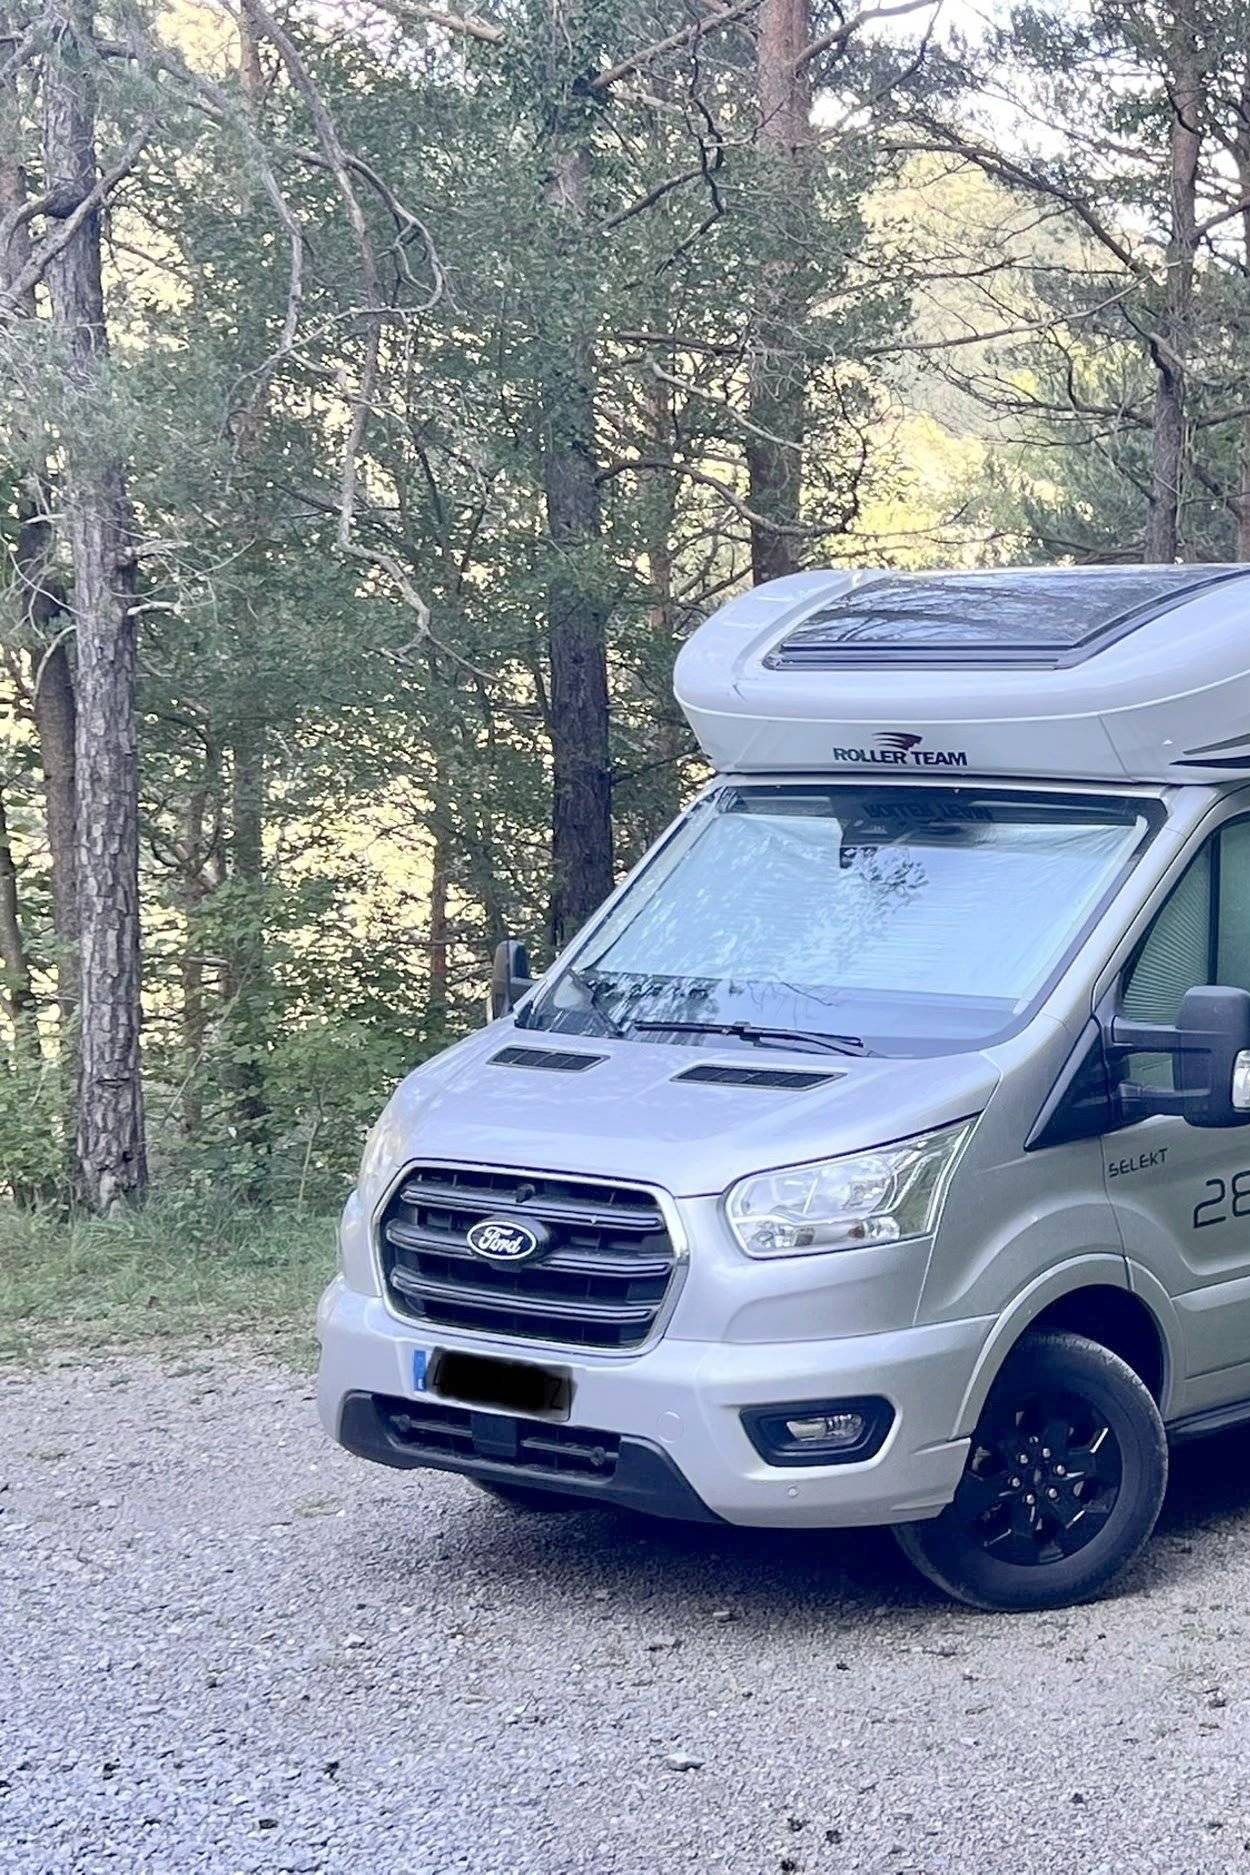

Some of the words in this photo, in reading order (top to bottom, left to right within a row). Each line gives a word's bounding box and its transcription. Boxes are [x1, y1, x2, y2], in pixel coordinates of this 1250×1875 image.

[833, 748, 907, 765] ROLLER
[911, 751, 967, 766] TEAM
[1109, 1148, 1168, 1178] SELEKT
[478, 1226, 524, 1254] Ford
